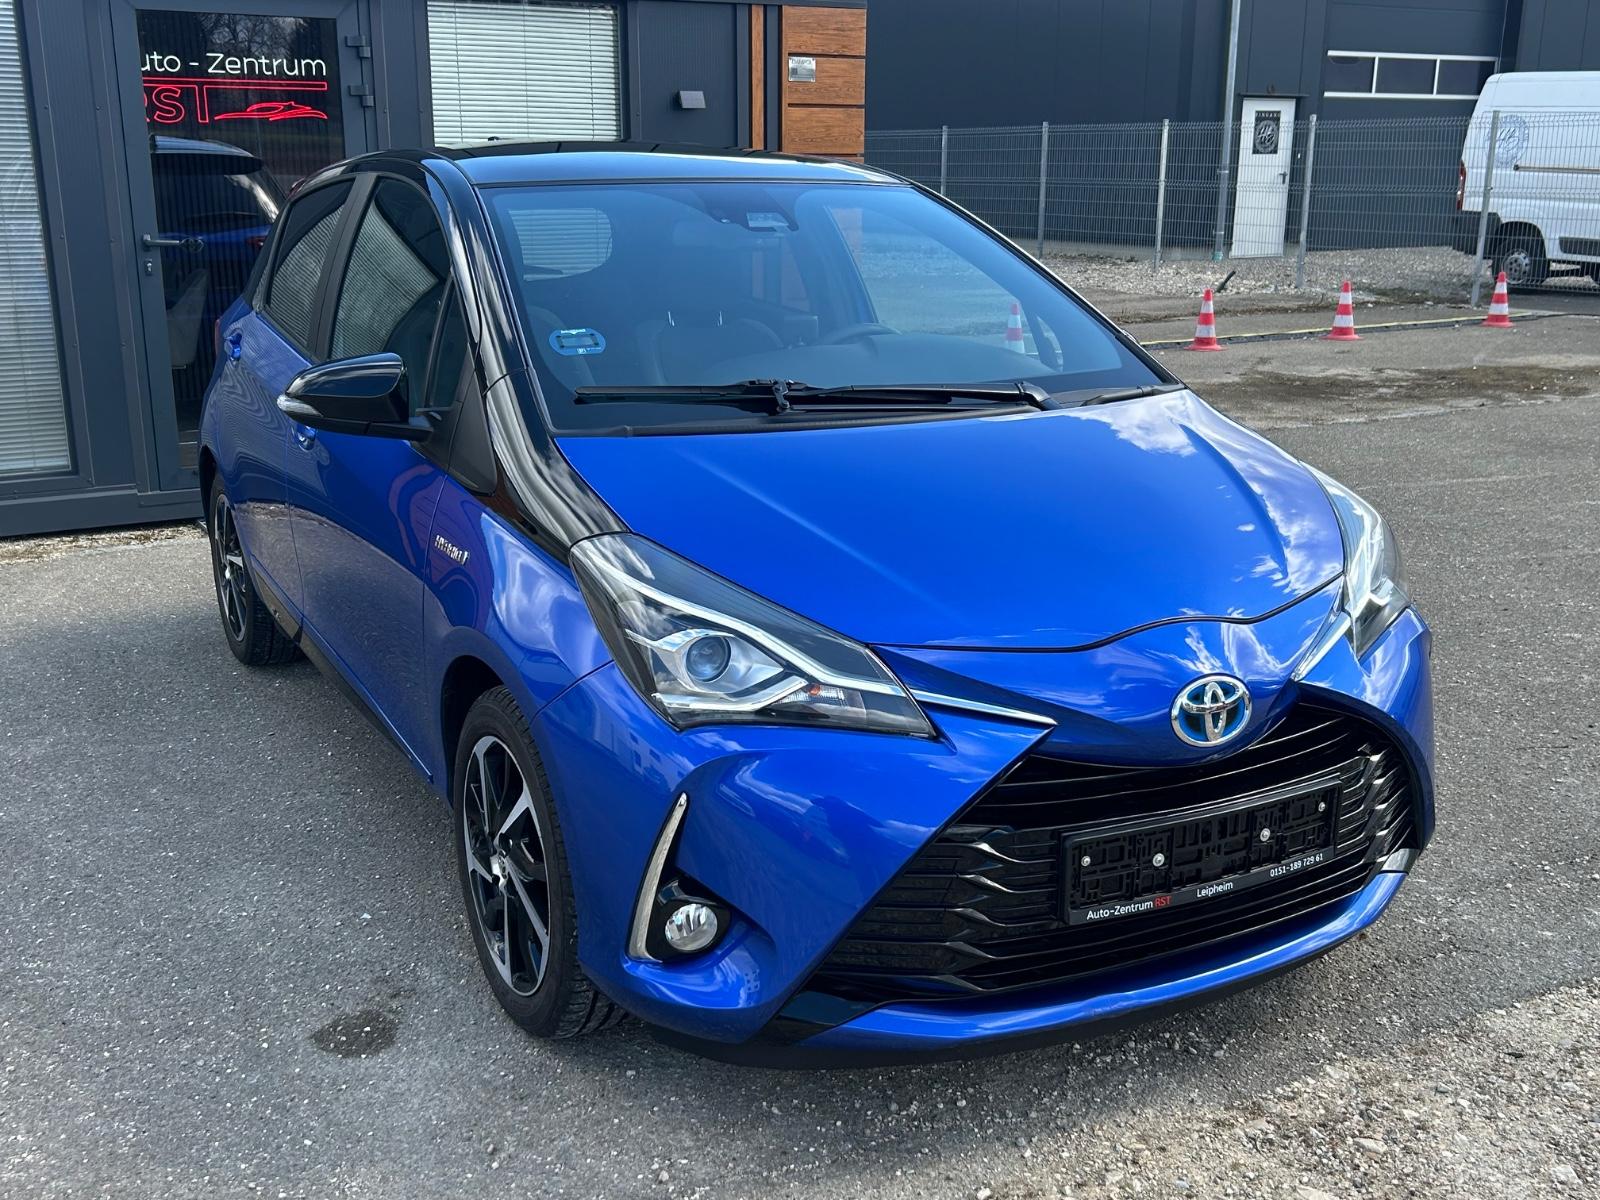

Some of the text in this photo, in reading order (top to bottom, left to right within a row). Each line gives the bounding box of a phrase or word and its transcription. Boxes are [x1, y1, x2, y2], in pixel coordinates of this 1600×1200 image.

[141, 51, 181, 72] uto
[206, 52, 327, 76] Zentrum
[143, 83, 209, 124] ST
[1086, 900, 1154, 920] Auto-Zentrum
[1154, 895, 1172, 909] RST
[1196, 881, 1234, 898] Leipheim
[1315, 852, 1323, 862] 61
